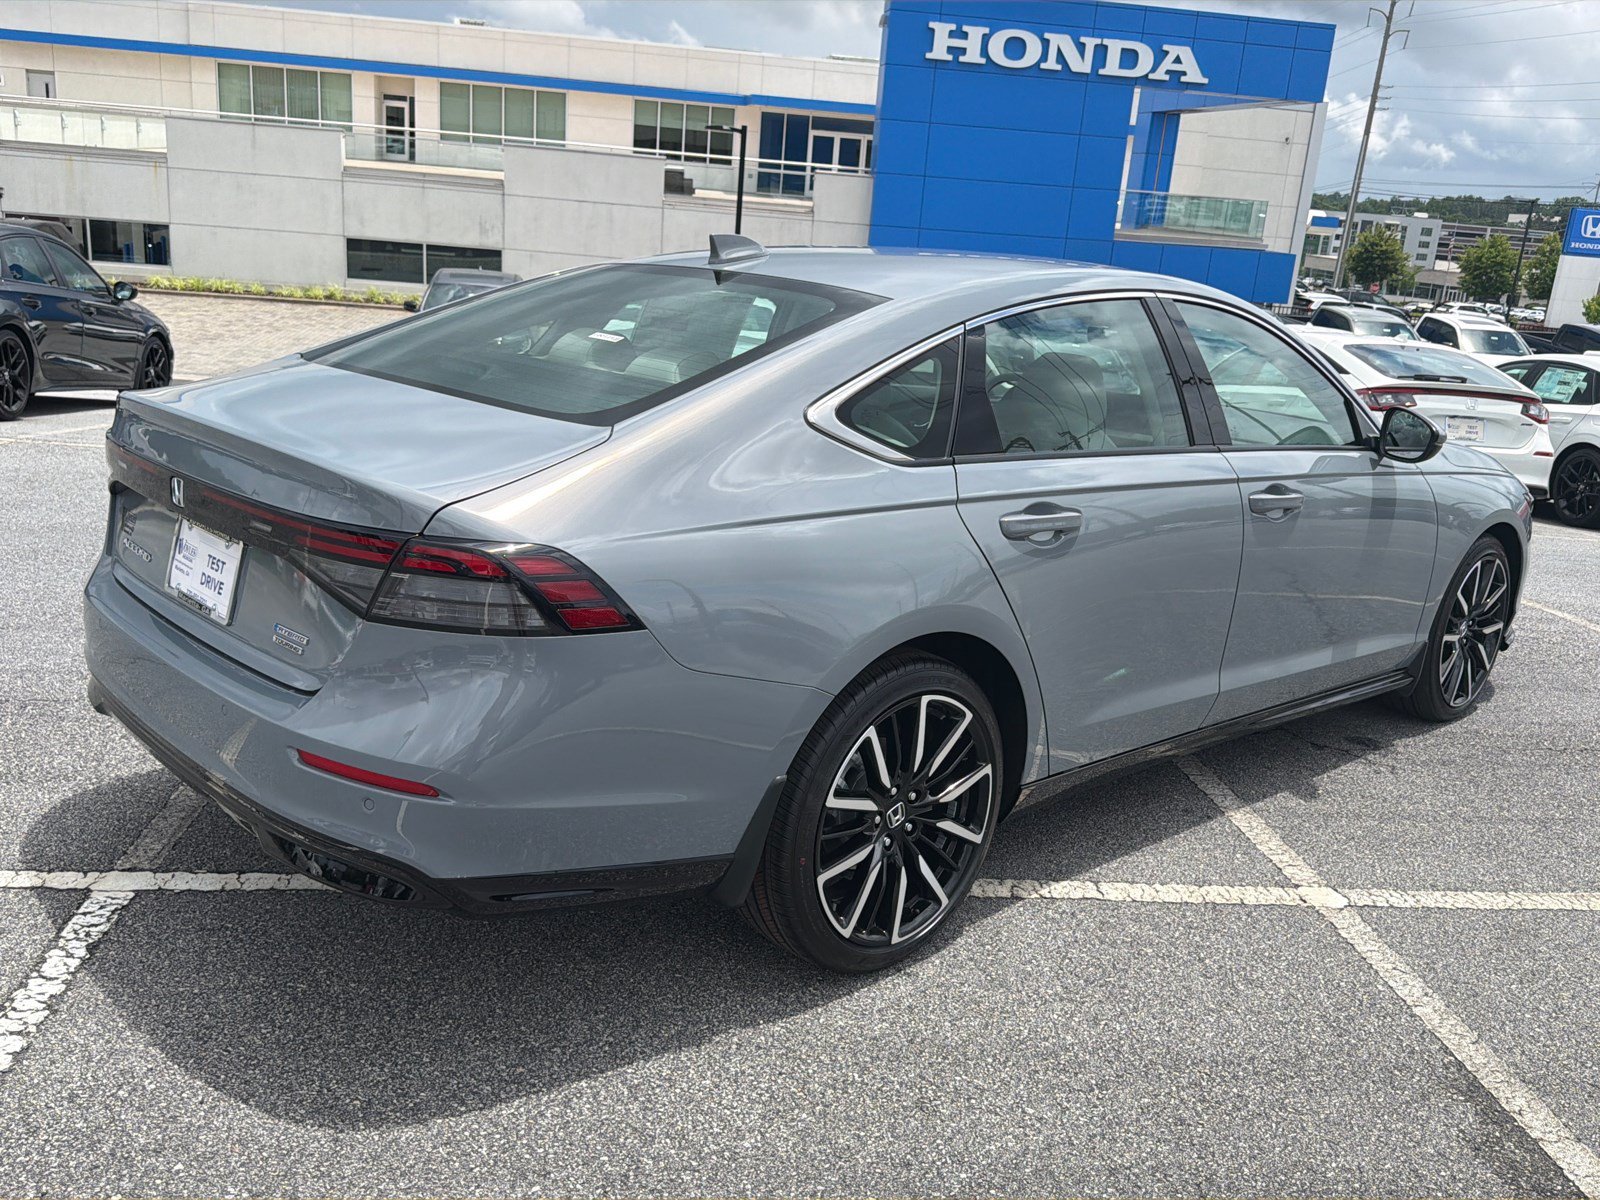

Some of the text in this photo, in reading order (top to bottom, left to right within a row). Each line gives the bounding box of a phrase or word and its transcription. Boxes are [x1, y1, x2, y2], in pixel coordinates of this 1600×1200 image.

[925, 21, 1209, 84] HONDA
[123, 538, 151, 562] ACCORD
[207, 554, 226, 574] TEST
[200, 571, 224, 596] DRIVE
